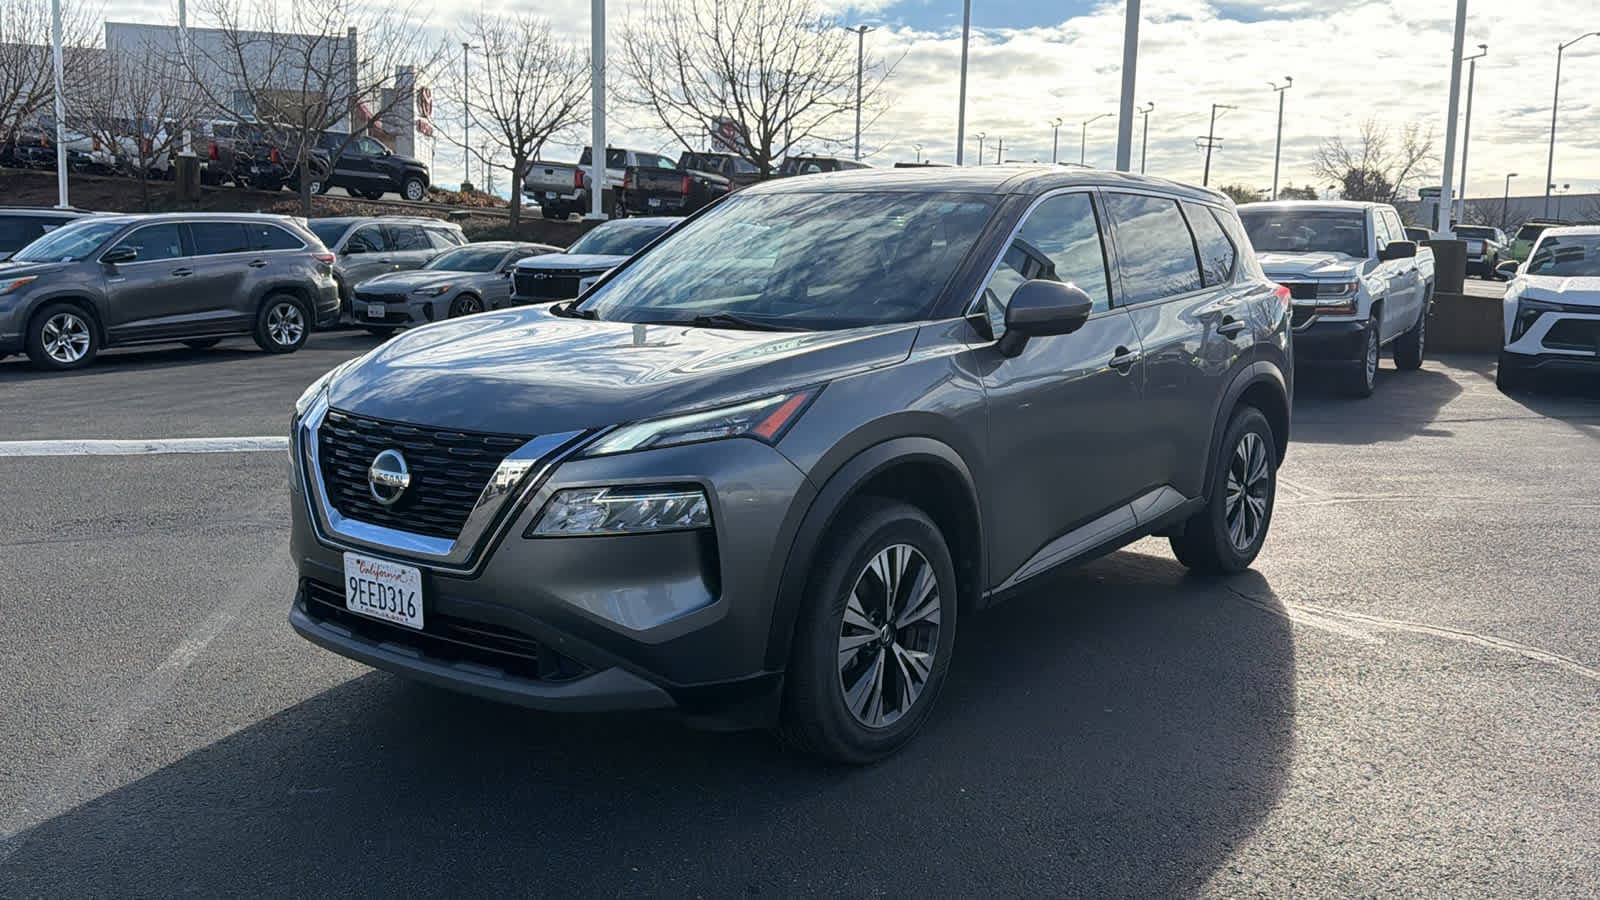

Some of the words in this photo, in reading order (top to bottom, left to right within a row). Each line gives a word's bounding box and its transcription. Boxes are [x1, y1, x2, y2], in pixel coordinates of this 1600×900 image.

[373, 471, 406, 484] SSAN
[359, 560, 402, 581] California
[349, 576, 416, 618] 9EED316
